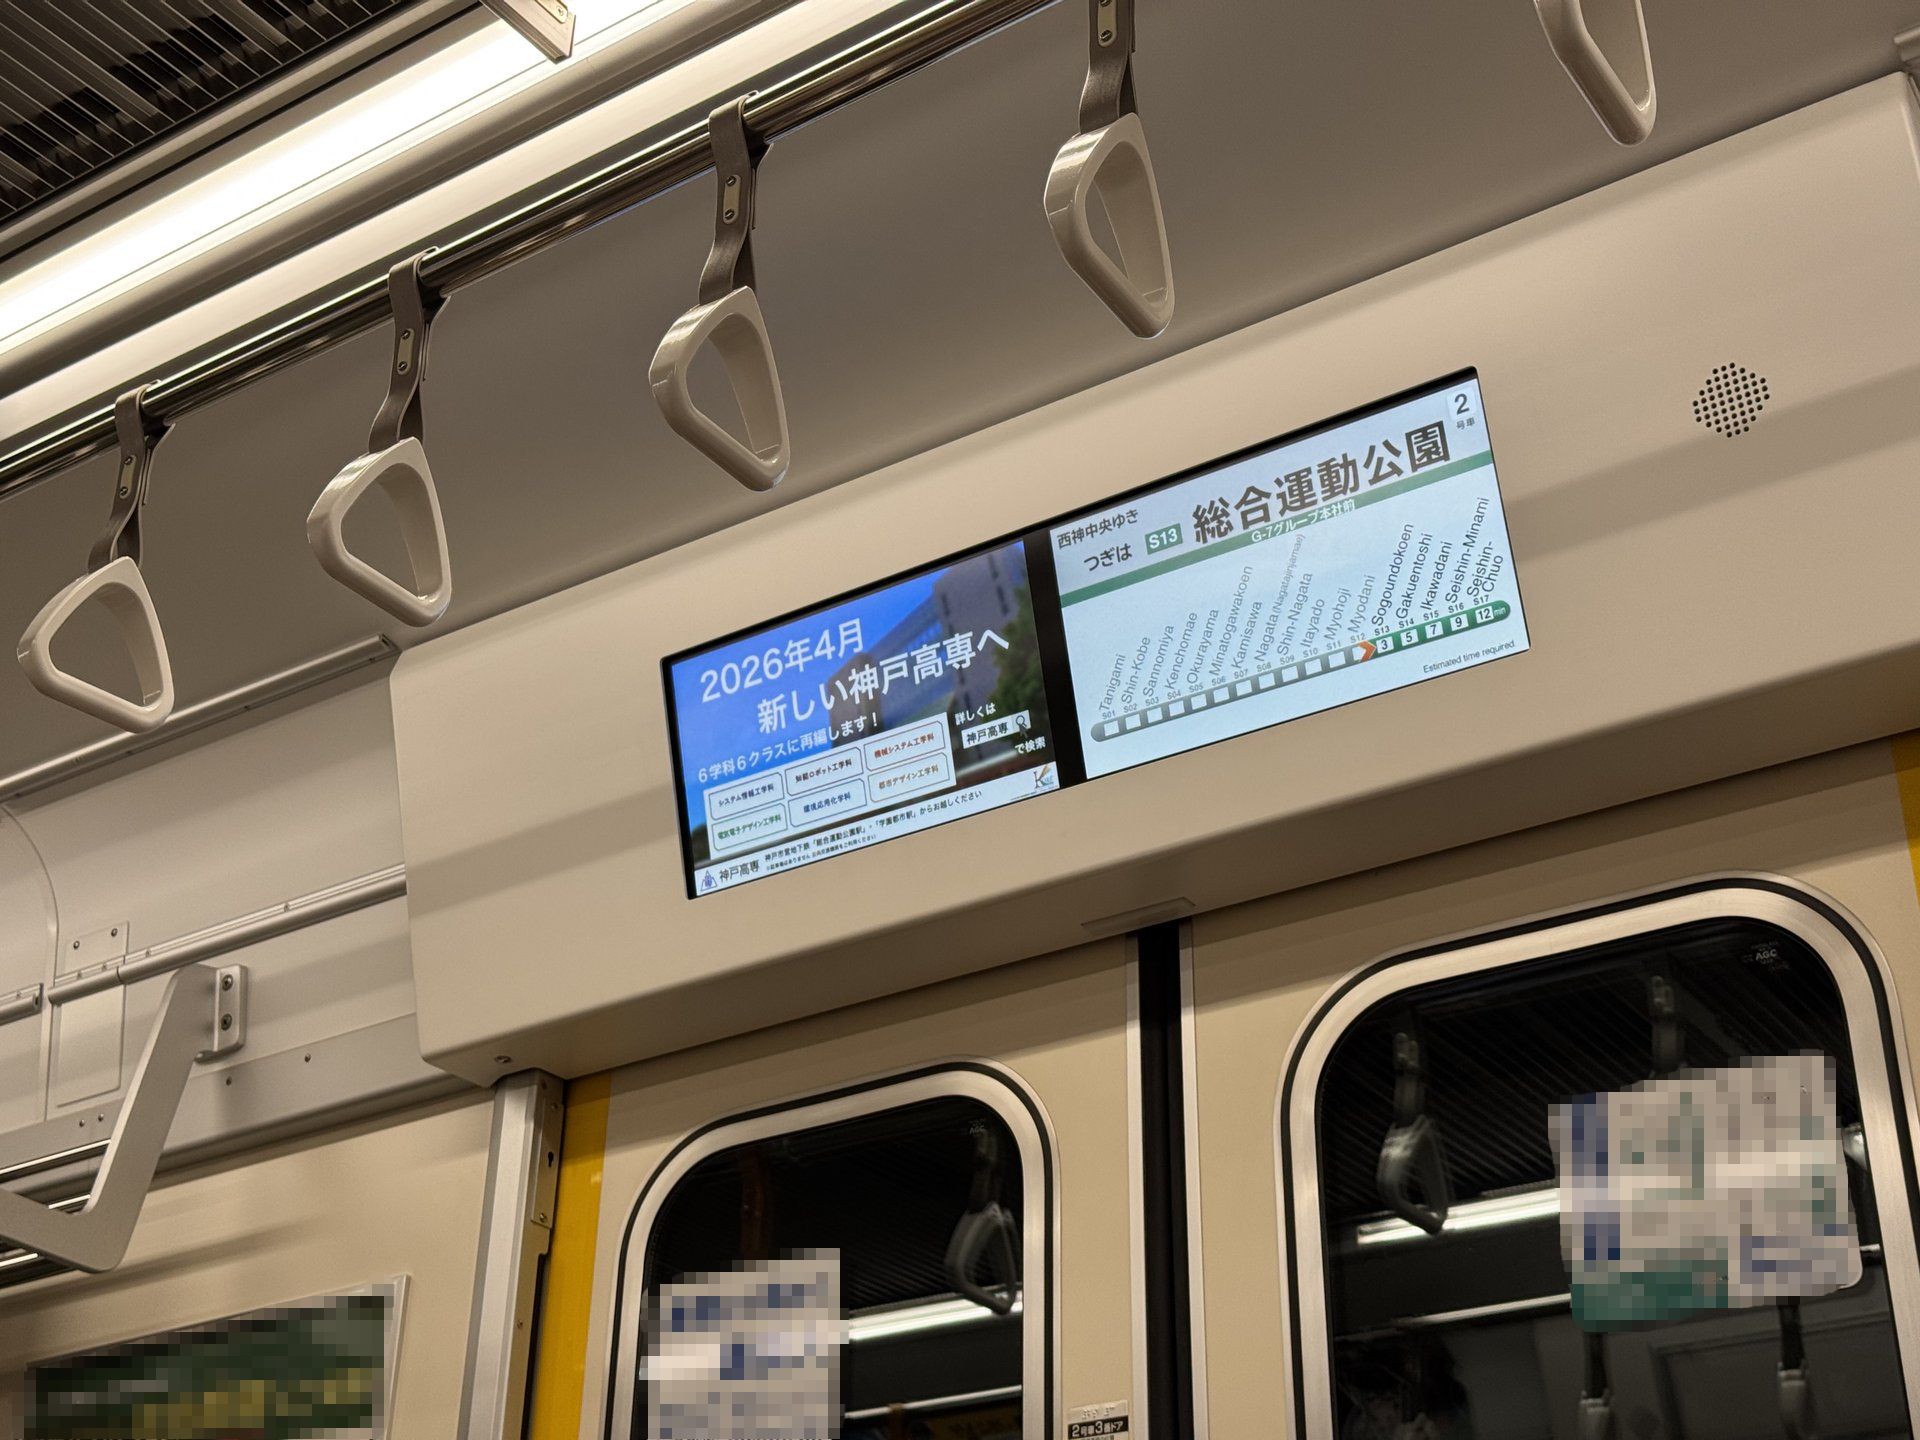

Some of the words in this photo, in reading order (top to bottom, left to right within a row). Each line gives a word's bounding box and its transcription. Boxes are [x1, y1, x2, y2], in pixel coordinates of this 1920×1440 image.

[1454, 393, 1470, 415] 2
[1455, 417, 1476, 431] 号車
[1192, 420, 1451, 545] 総合運動公園
[1057, 508, 1139, 550] 西神中央ゆき
[1251, 499, 1356, 543] G-7グループ本社前
[1149, 528, 1178, 549] S13
[1445, 497, 1490, 604] Seishin-Minami
[1084, 543, 1132, 572] つぎは
[1467, 541, 1492, 597] Seishin-
[1371, 523, 1414, 626] Sogoundokoen
[1395, 533, 1433, 620] Gakuentoshi
[1420, 541, 1452, 611] Ikawadani
[1482, 555, 1503, 593] Chuo
[1347, 574, 1376, 633] Myodani
[1447, 602, 1465, 614] S16
[1472, 594, 1490, 606] S17
[1209, 565, 1254, 676] Minatogawakoen
[1277, 573, 1313, 656] Shin-Nagata
[1300, 599, 1325, 648] Itayado
[1324, 588, 1352, 640] Myohoji
[1398, 618, 1415, 629] S14
[1422, 610, 1440, 621] S15
[1455, 616, 1463, 627] 9
[1477, 608, 1491, 620] 12
[1493, 607, 1507, 616] min
[1231, 601, 1262, 669] Kamisawa
[1350, 633, 1366, 644] S12
[1374, 625, 1391, 637] S13
[1405, 631, 1413, 643] 5
[1430, 624, 1437, 635] 7
[1164, 612, 1198, 690] Kenchomae
[1186, 609, 1219, 684] Okurayama
[1302, 647, 1319, 659] S10
[1326, 640, 1342, 651] S11
[1381, 639, 1389, 651] 3
[1423, 653, 1462, 673] Estimated
[1463, 648, 1480, 662] time
[1481, 639, 1516, 659] required
[700, 618, 864, 703] 2026年4月
[1121, 637, 1151, 704] Shin-Kobe
[1143, 625, 1174, 697] Sannomiya
[1256, 662, 1272, 673] S08
[1279, 655, 1295, 666] S09
[757, 629, 1010, 735] 新しい神戸高専へ
[1099, 653, 1126, 711] Tanigami
[1211, 676, 1226, 686] S06
[1233, 669, 1249, 679] S07
[1167, 690, 1182, 700] S04
[1189, 683, 1204, 693] S05
[1123, 703, 1138, 713] S02
[1145, 696, 1159, 707] S03
[954, 702, 997, 726] 詳しくは
[1102, 710, 1116, 720] S01
[874, 732, 935, 759] 機械システム工学科
[966, 722, 1008, 745] 神戸高専
[1014, 736, 1046, 754] で検索
[795, 759, 852, 783] 知能ロボット工学科
[878, 764, 939, 790] 都市デザイン工学科
[718, 783, 775, 807] システム情報工学科
[803, 792, 852, 813] 環境応用化学科
[719, 859, 760, 883] 神戸高専
[1755, 949, 1777, 961] AGC
